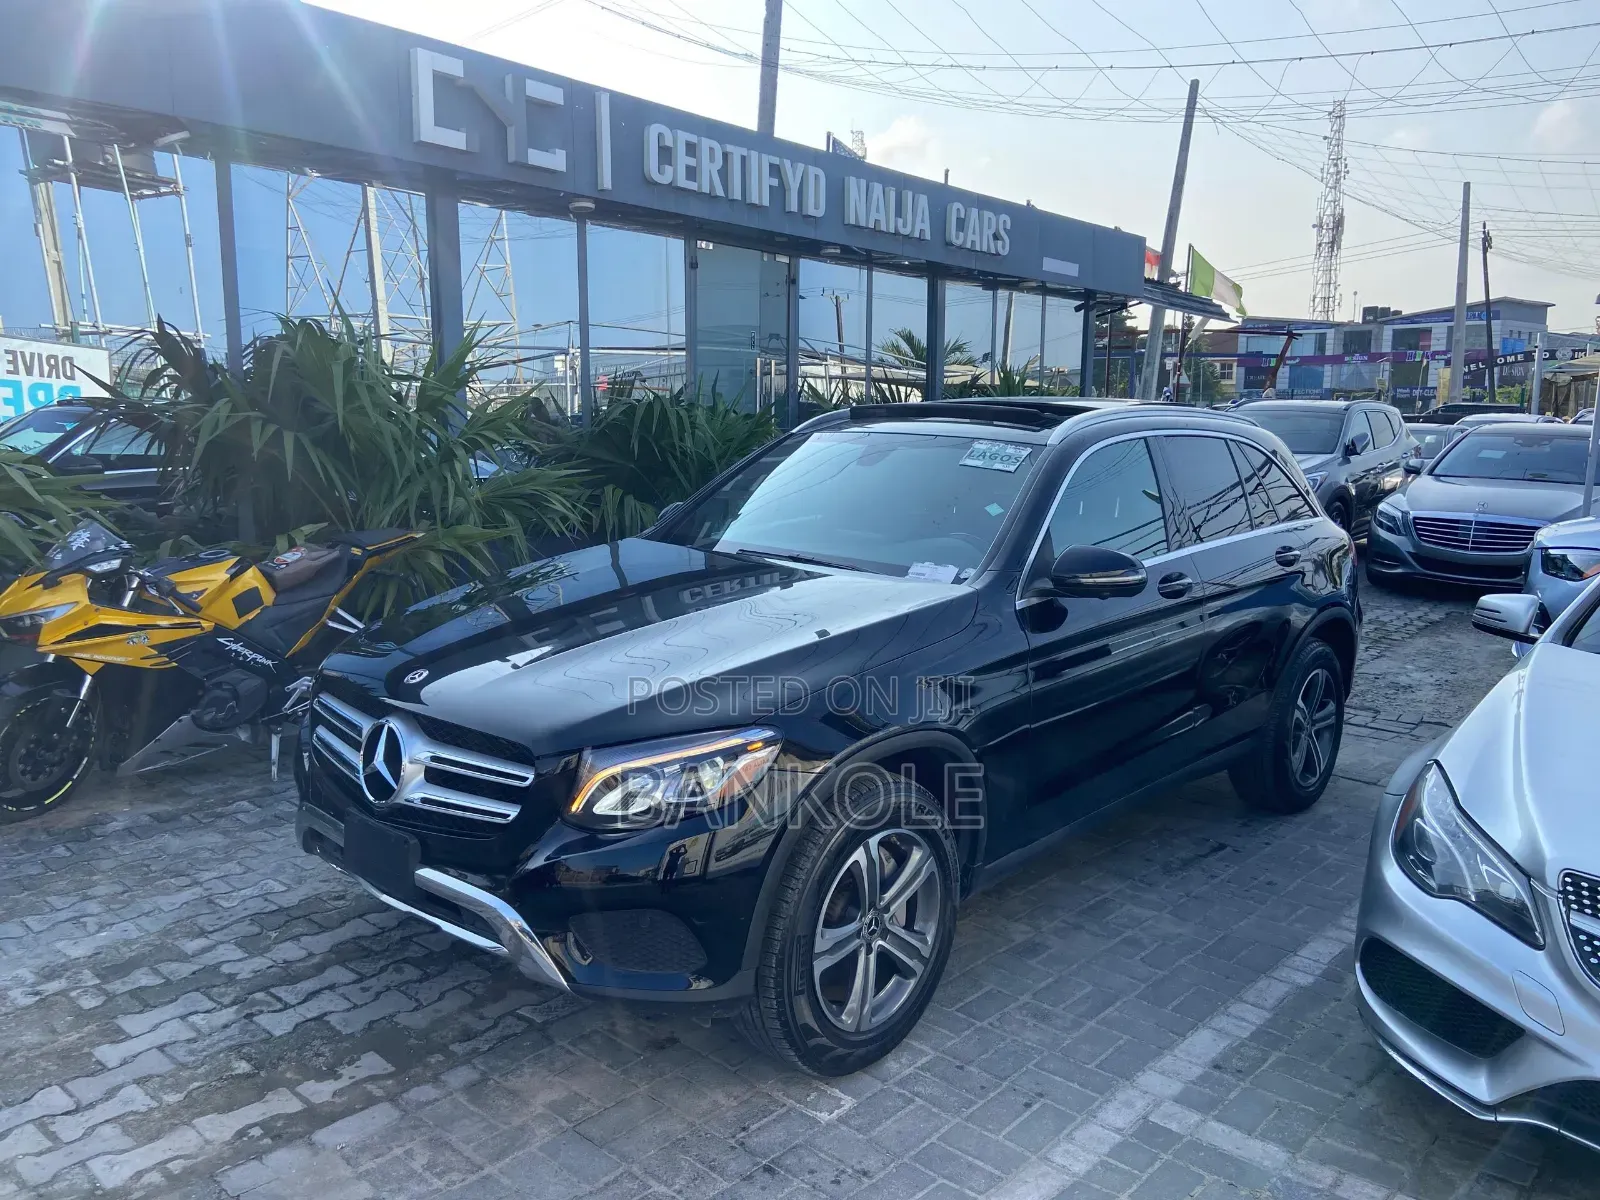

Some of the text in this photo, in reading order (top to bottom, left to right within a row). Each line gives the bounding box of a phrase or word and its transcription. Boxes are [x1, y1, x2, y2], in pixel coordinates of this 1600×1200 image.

[644, 123, 1011, 256] CERTIFYD NAIJA CARS
[1462, 353, 1525, 373] ELOME
[965, 449, 1023, 465] LAGOS
